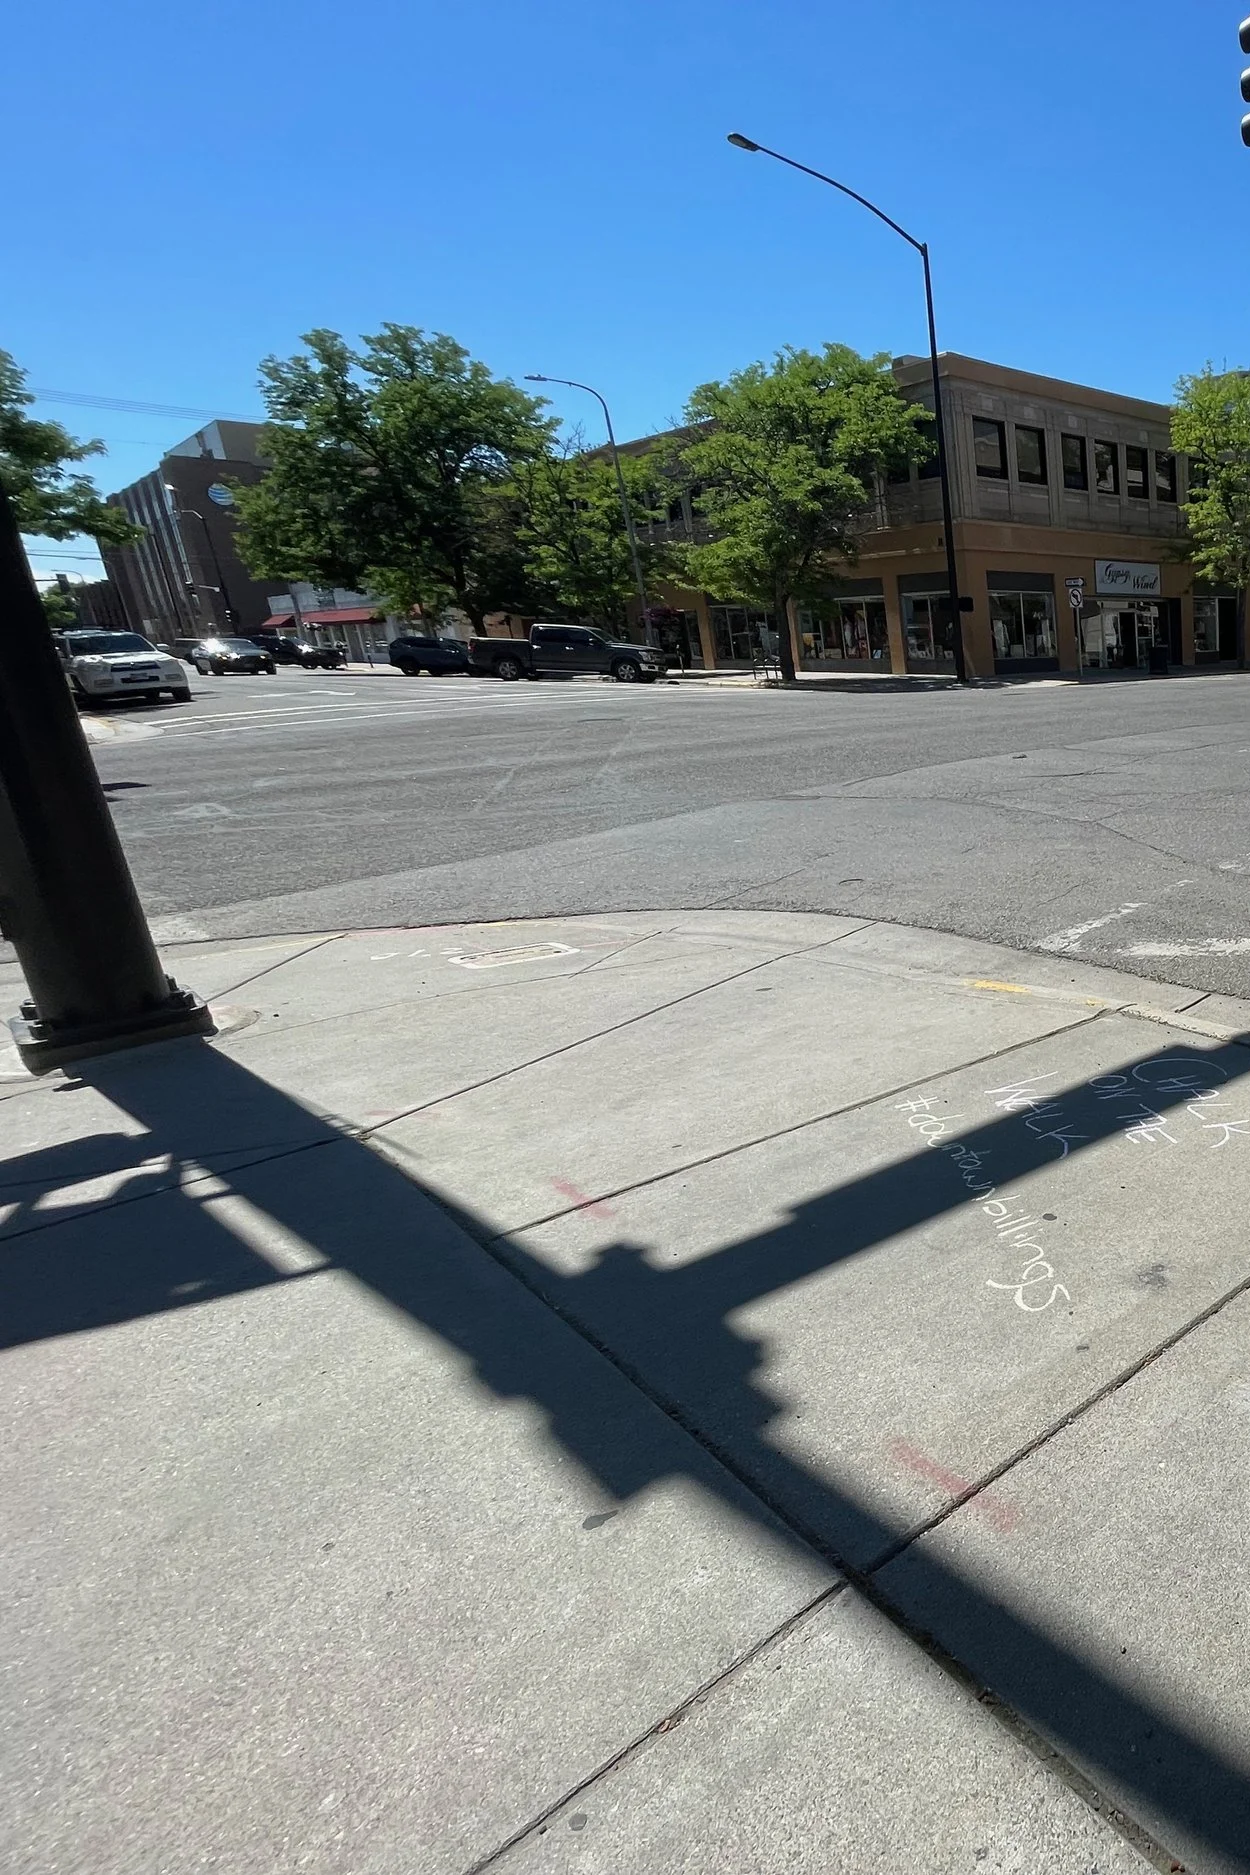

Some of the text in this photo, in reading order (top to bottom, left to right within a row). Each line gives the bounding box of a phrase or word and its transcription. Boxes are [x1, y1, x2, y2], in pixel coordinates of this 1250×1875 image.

[1132, 574, 1159, 590] Wind
[1088, 1074, 1142, 1100] ON
[984, 1071, 1091, 1160] WALK
